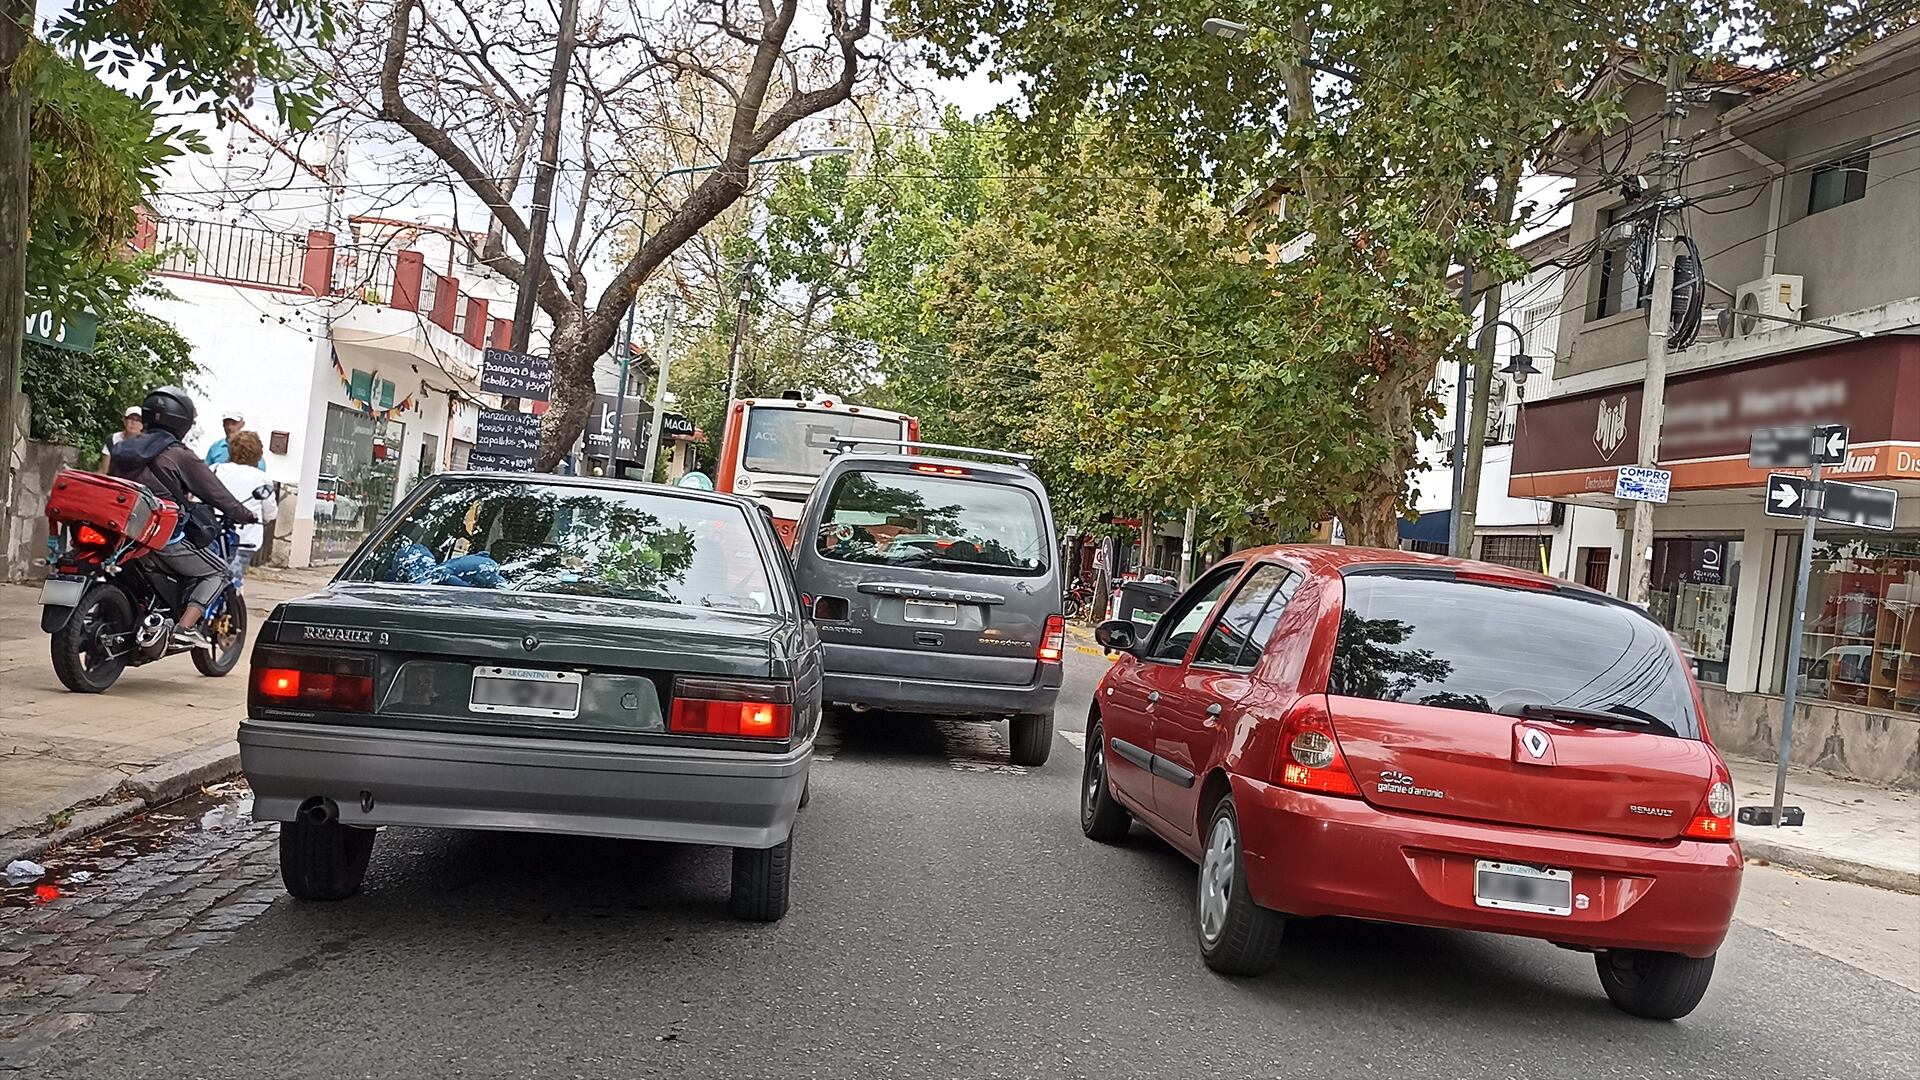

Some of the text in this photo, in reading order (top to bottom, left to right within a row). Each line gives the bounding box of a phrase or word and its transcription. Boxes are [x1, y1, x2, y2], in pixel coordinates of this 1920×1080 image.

[484, 362, 520, 376] Banana
[482, 374, 510, 387] Cebolla
[1620, 467, 1669, 480] COMPRO
[303, 626, 389, 645] RENAULT 9
[508, 670, 550, 679] ARGENTINA
[1380, 771, 1414, 785] Clio
[1630, 805, 1674, 817] RENAULT
[1506, 865, 1542, 876] ARGENTIN
